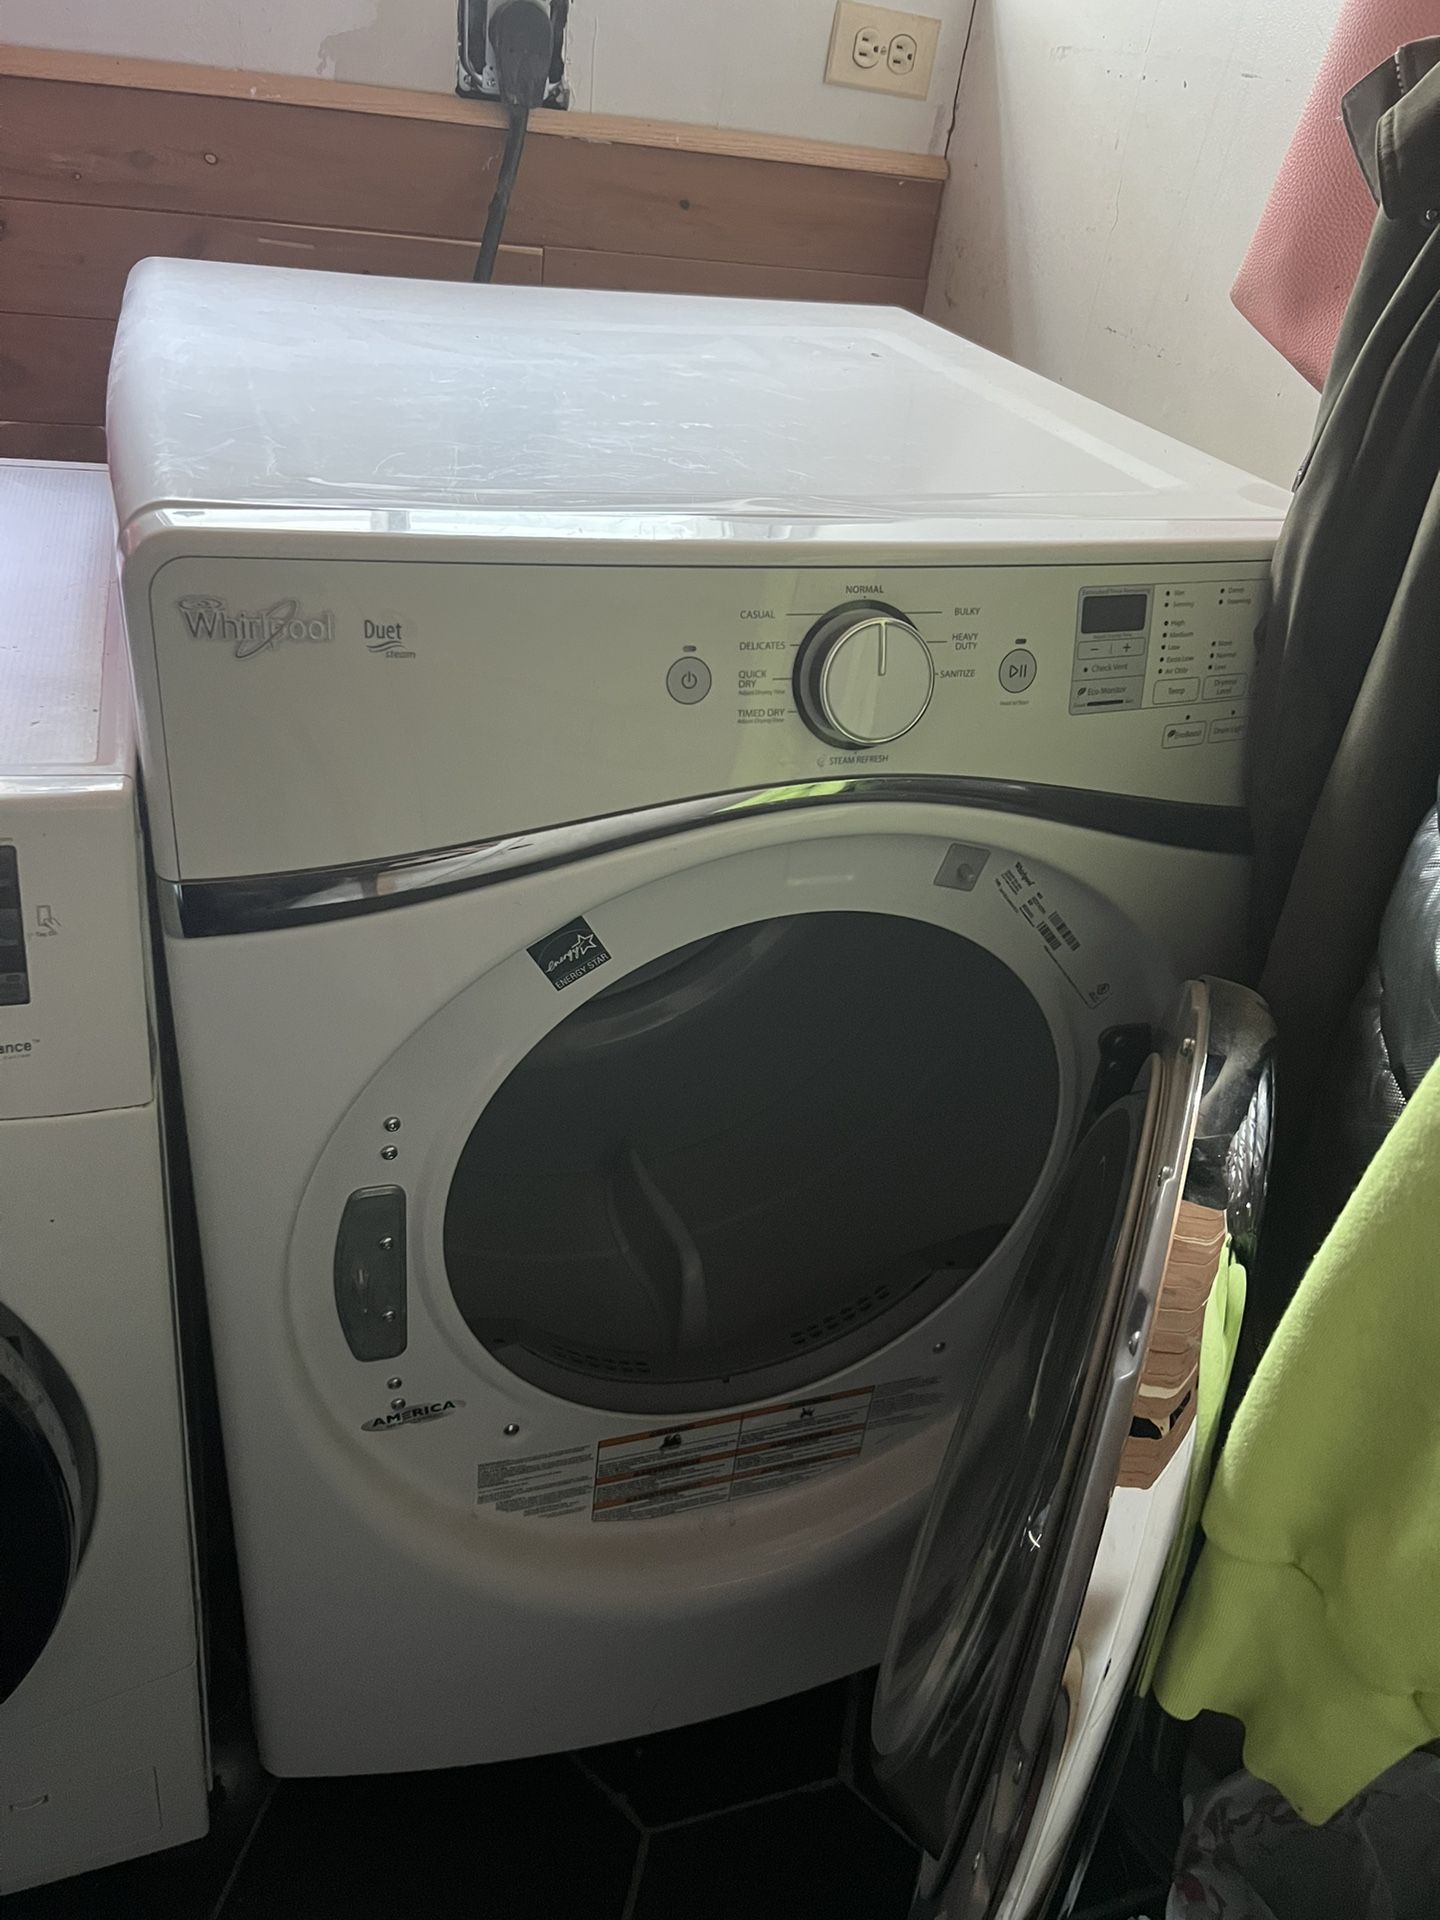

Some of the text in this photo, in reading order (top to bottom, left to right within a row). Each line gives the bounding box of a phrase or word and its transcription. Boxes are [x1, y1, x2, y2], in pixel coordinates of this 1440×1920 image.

[845, 585, 884, 594] NORMAL
[740, 610, 776, 619] CASUAL
[954, 607, 981, 616] BULKY
[180, 608, 335, 649] Whirlpool
[364, 619, 402, 640] Duet
[952, 632, 979, 641] HEAVY
[739, 641, 786, 651] DELICATES
[955, 641, 978, 650] DUTY
[738, 670, 767, 679] QUICK
[940, 668, 976, 679] SANITIZE
[738, 679, 757, 689] DRY
[737, 708, 785, 718] TIMED DRY
[829, 755, 889, 766] STEAM REFRESH
[554, 952, 610, 990] ENERGY STAR
[372, 1400, 456, 1427] AMERICA
